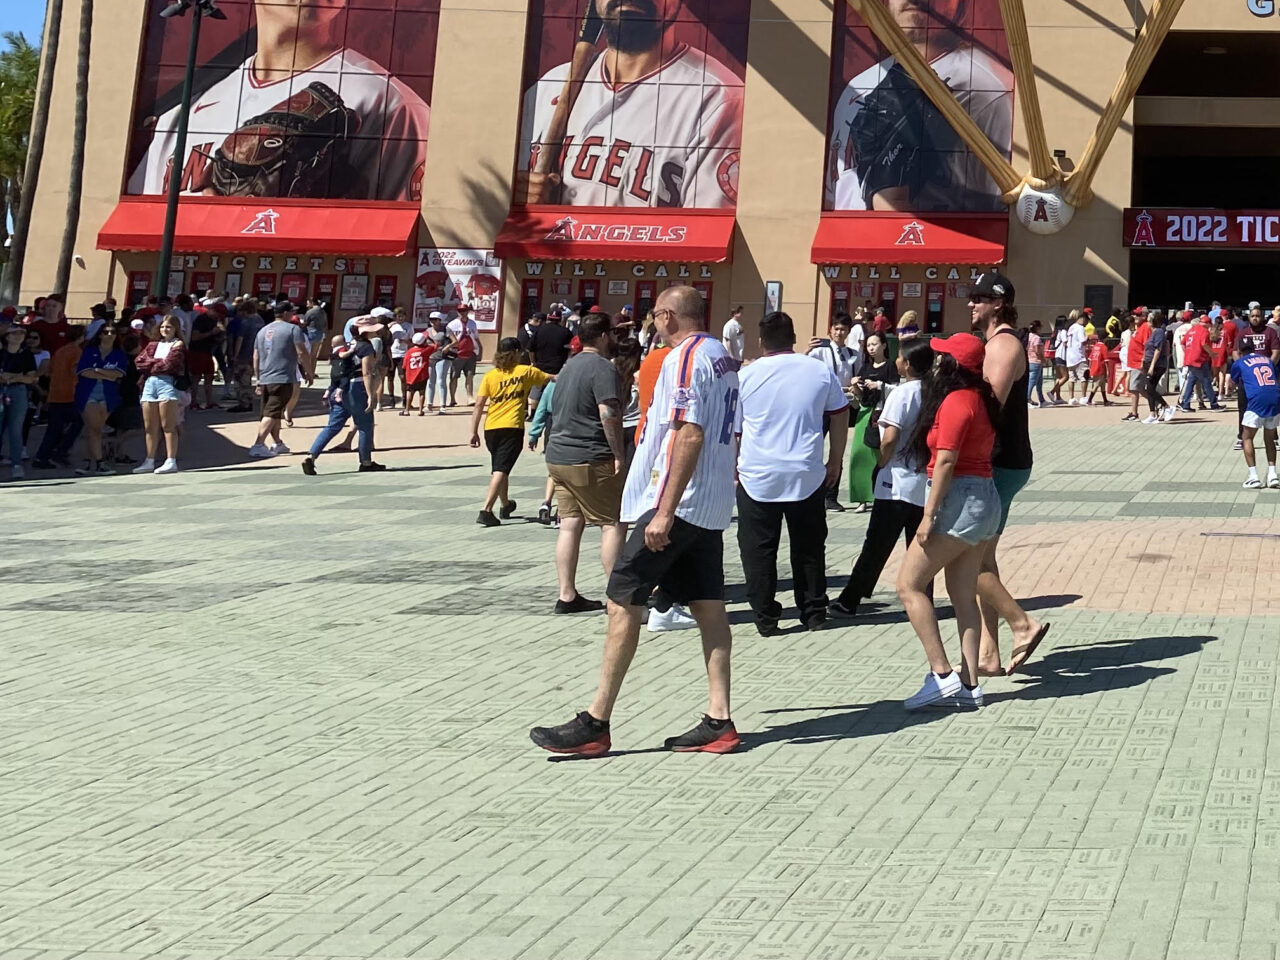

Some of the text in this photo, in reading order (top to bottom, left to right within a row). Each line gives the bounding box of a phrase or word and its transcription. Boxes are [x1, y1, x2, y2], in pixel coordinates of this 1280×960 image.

[545, 216, 687, 242] ANGELS
[1166, 216, 1228, 241] 2022
[432, 251, 457, 259] 2022
[184, 255, 347, 272] TICKETS
[526, 262, 712, 278] WILL CALL
[824, 266, 900, 279] WILL
[409, 356, 424, 370] 27
[1253, 366, 1276, 387] 12
